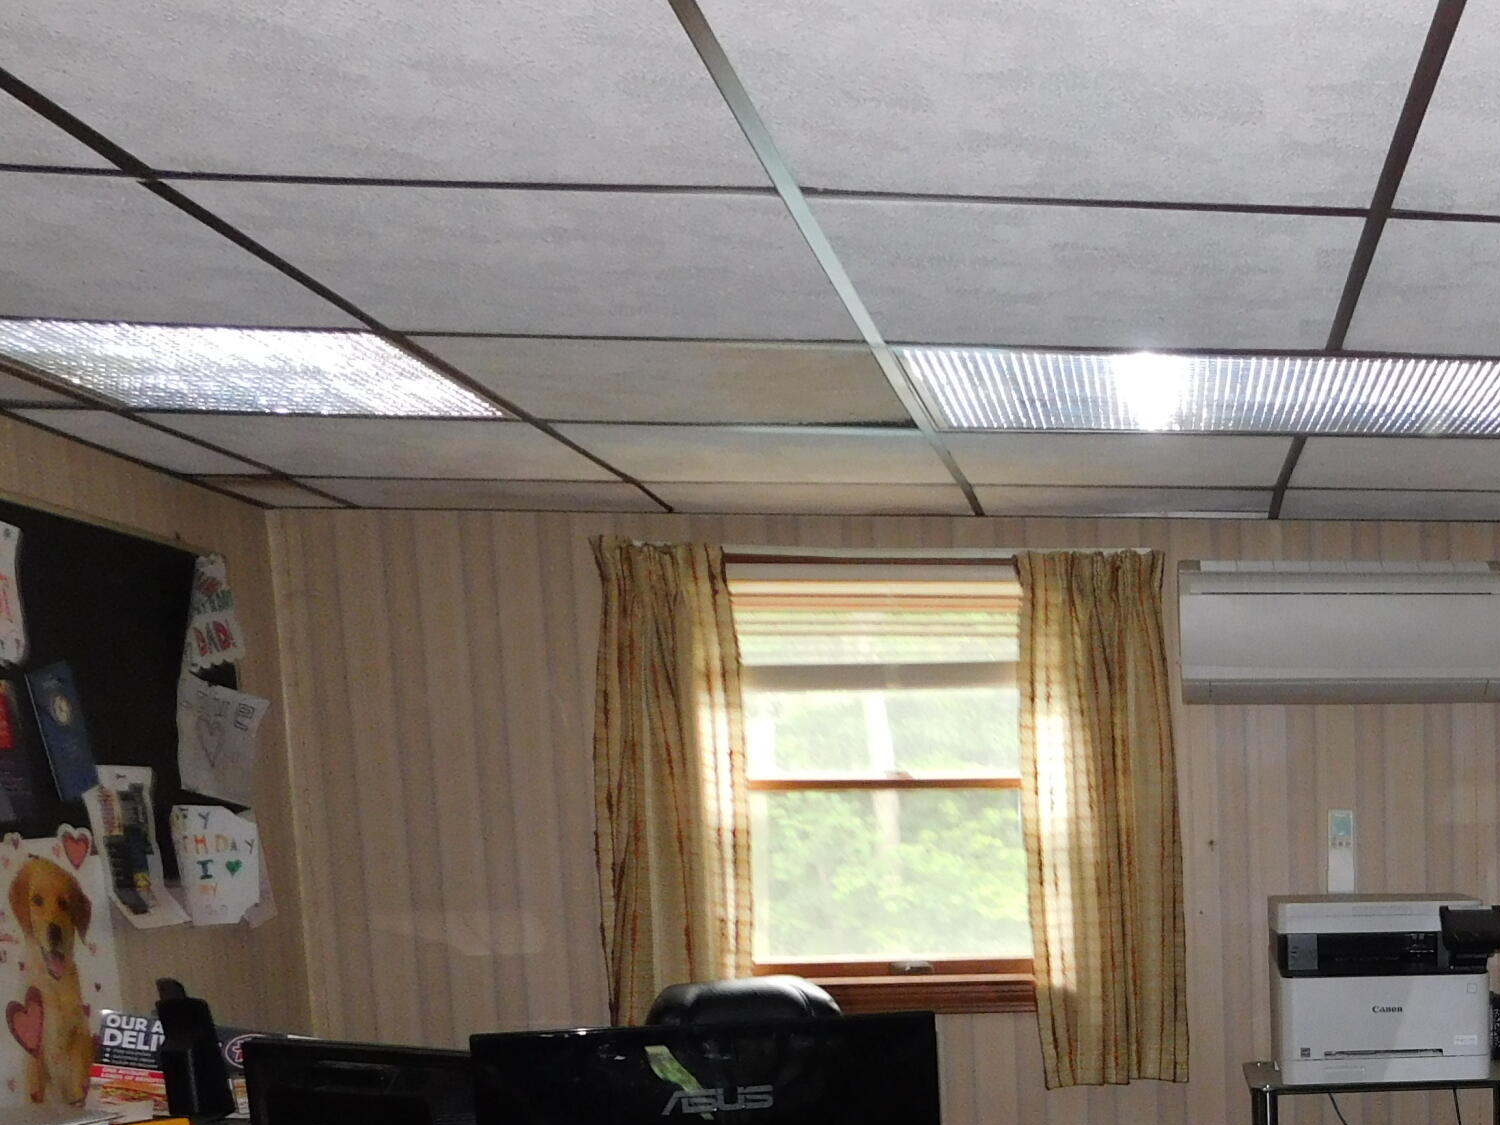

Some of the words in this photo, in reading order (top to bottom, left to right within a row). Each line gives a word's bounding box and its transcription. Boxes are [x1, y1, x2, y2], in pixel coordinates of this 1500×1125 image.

[1371, 1005, 1403, 1014] Canon
[106, 1013, 147, 1032] OUR
[660, 1084, 774, 1116] ASUS
